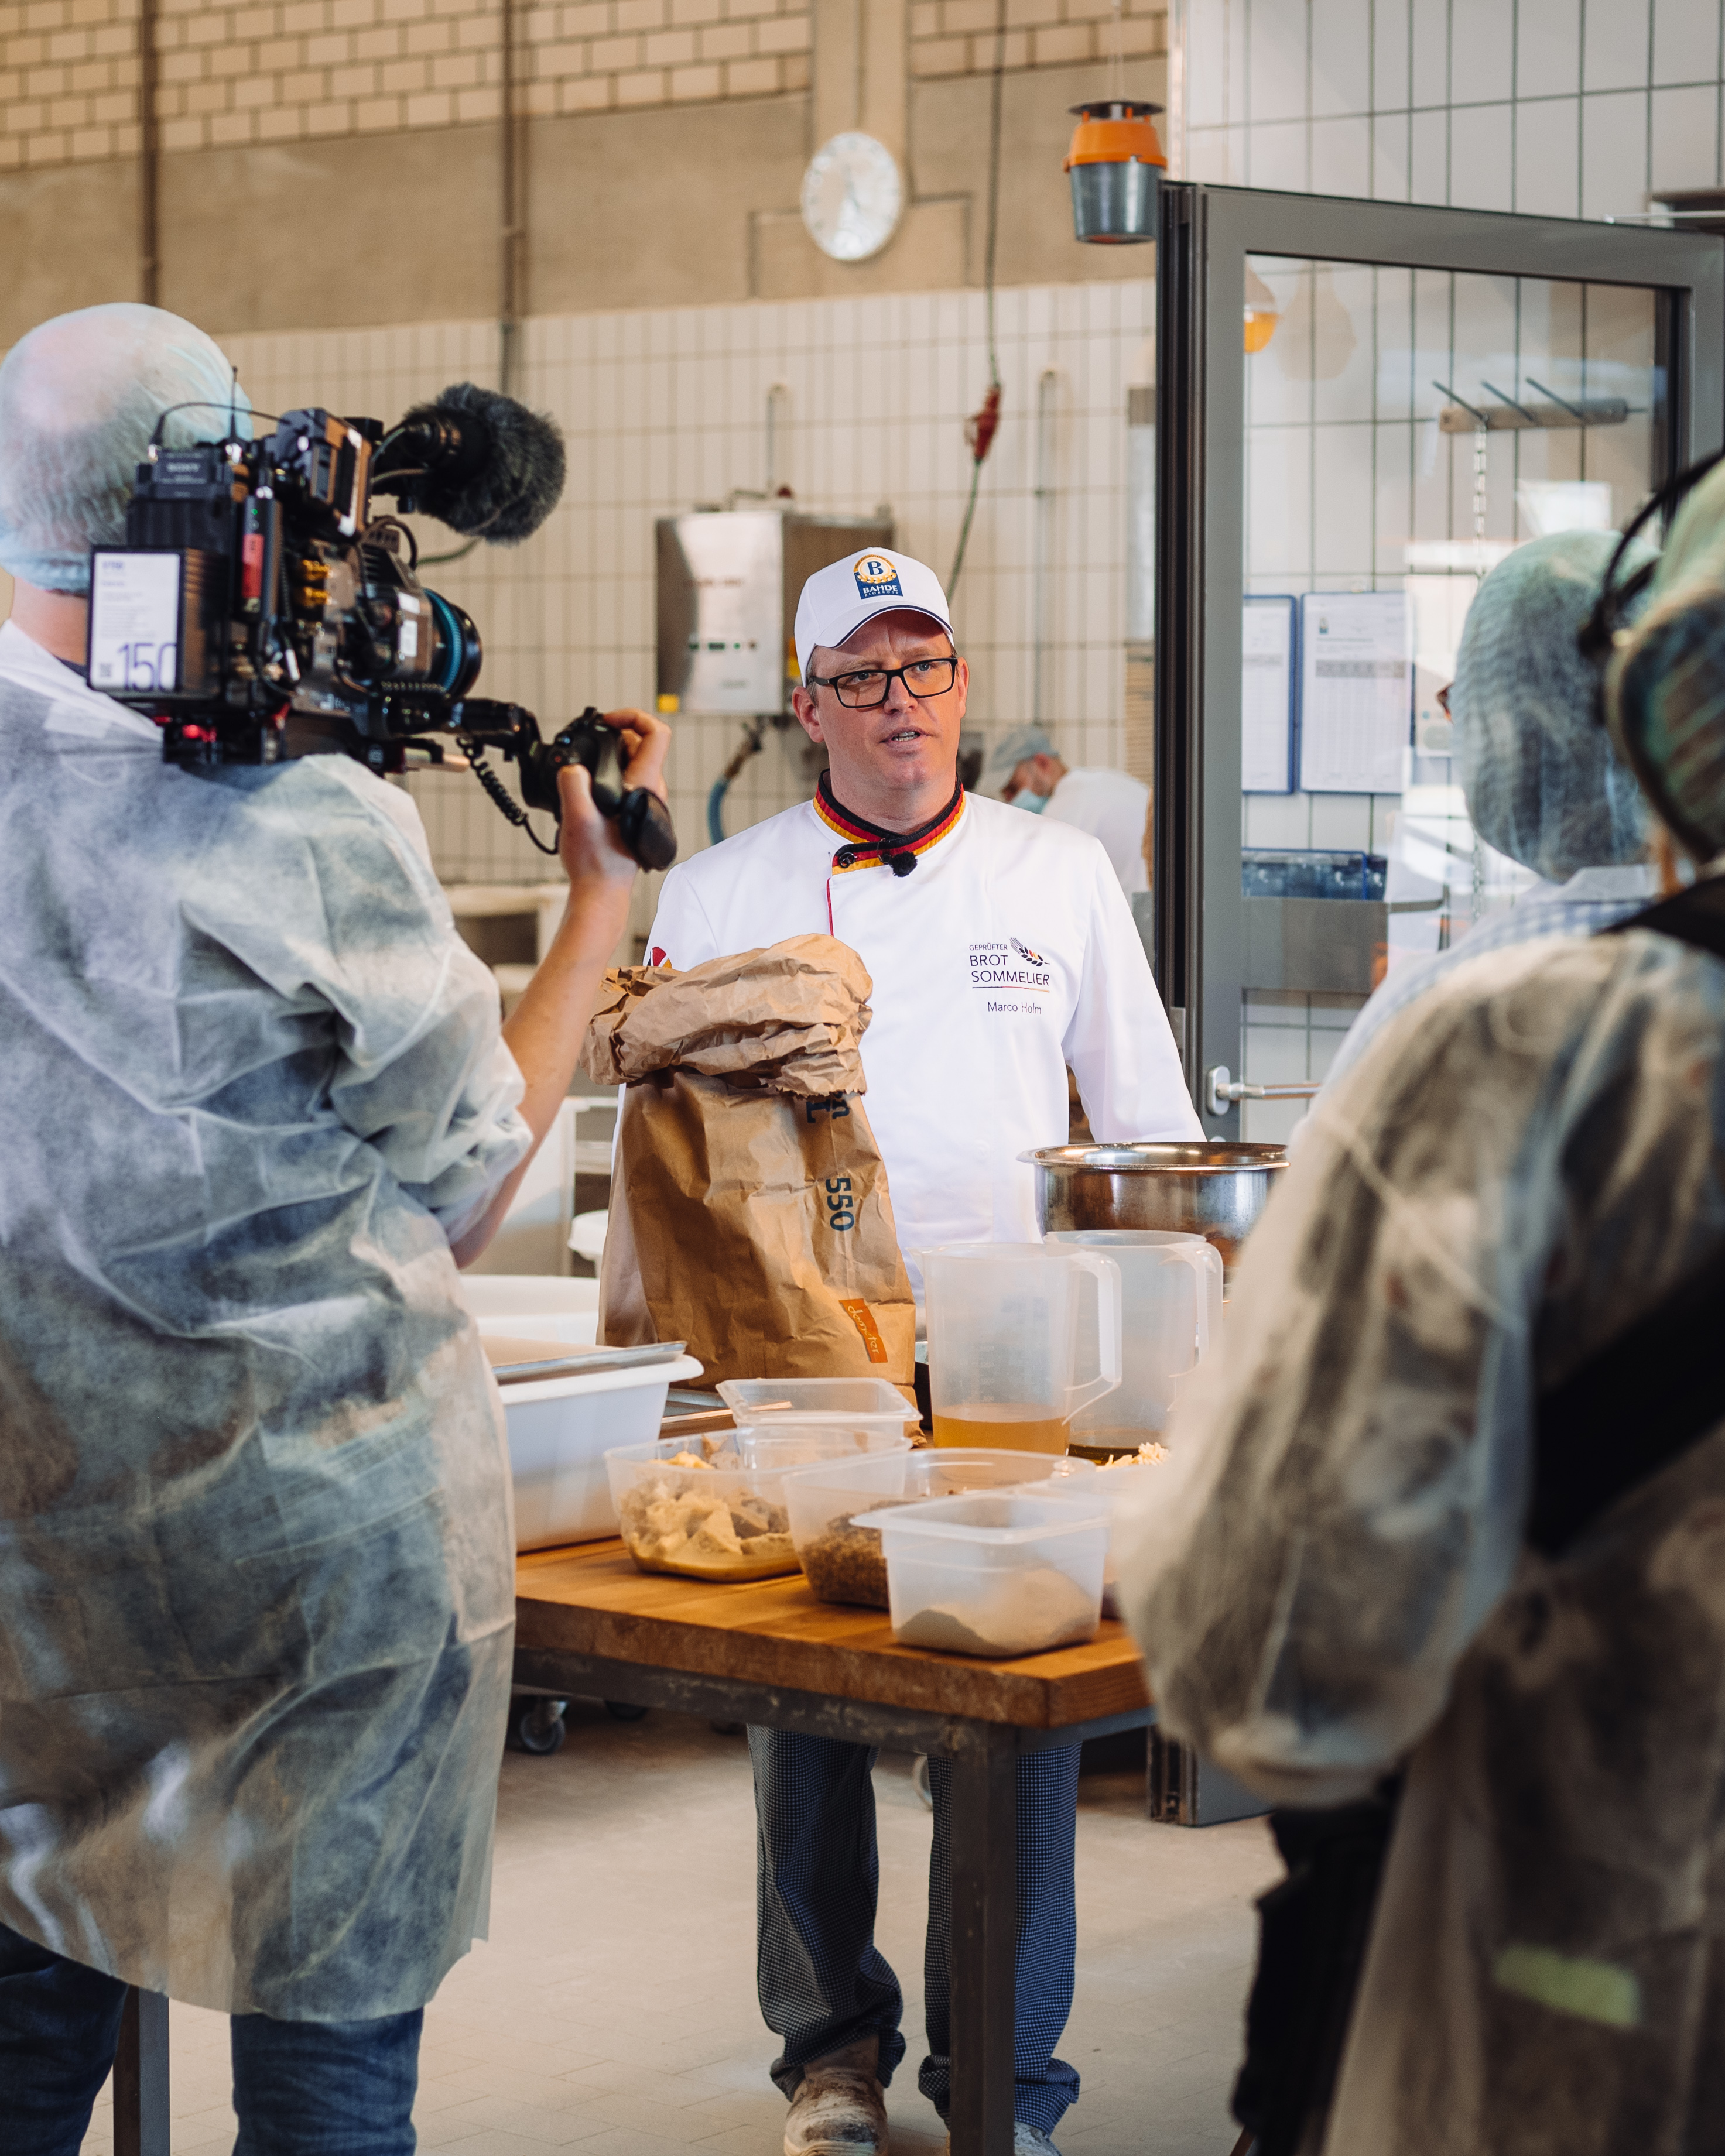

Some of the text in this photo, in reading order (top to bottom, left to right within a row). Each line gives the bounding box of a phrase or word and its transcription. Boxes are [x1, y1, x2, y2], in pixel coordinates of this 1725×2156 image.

[867, 561, 884, 575] B
[862, 585, 898, 594] BAHDE
[117, 642, 177, 693] 150
[969, 942, 1008, 951] GEPRÜFTER
[970, 954, 1008, 966] BROT
[971, 970, 1050, 986] SOMMELIER
[987, 1001, 1042, 1014] Marco Holm
[825, 1178, 855, 1232] 550
